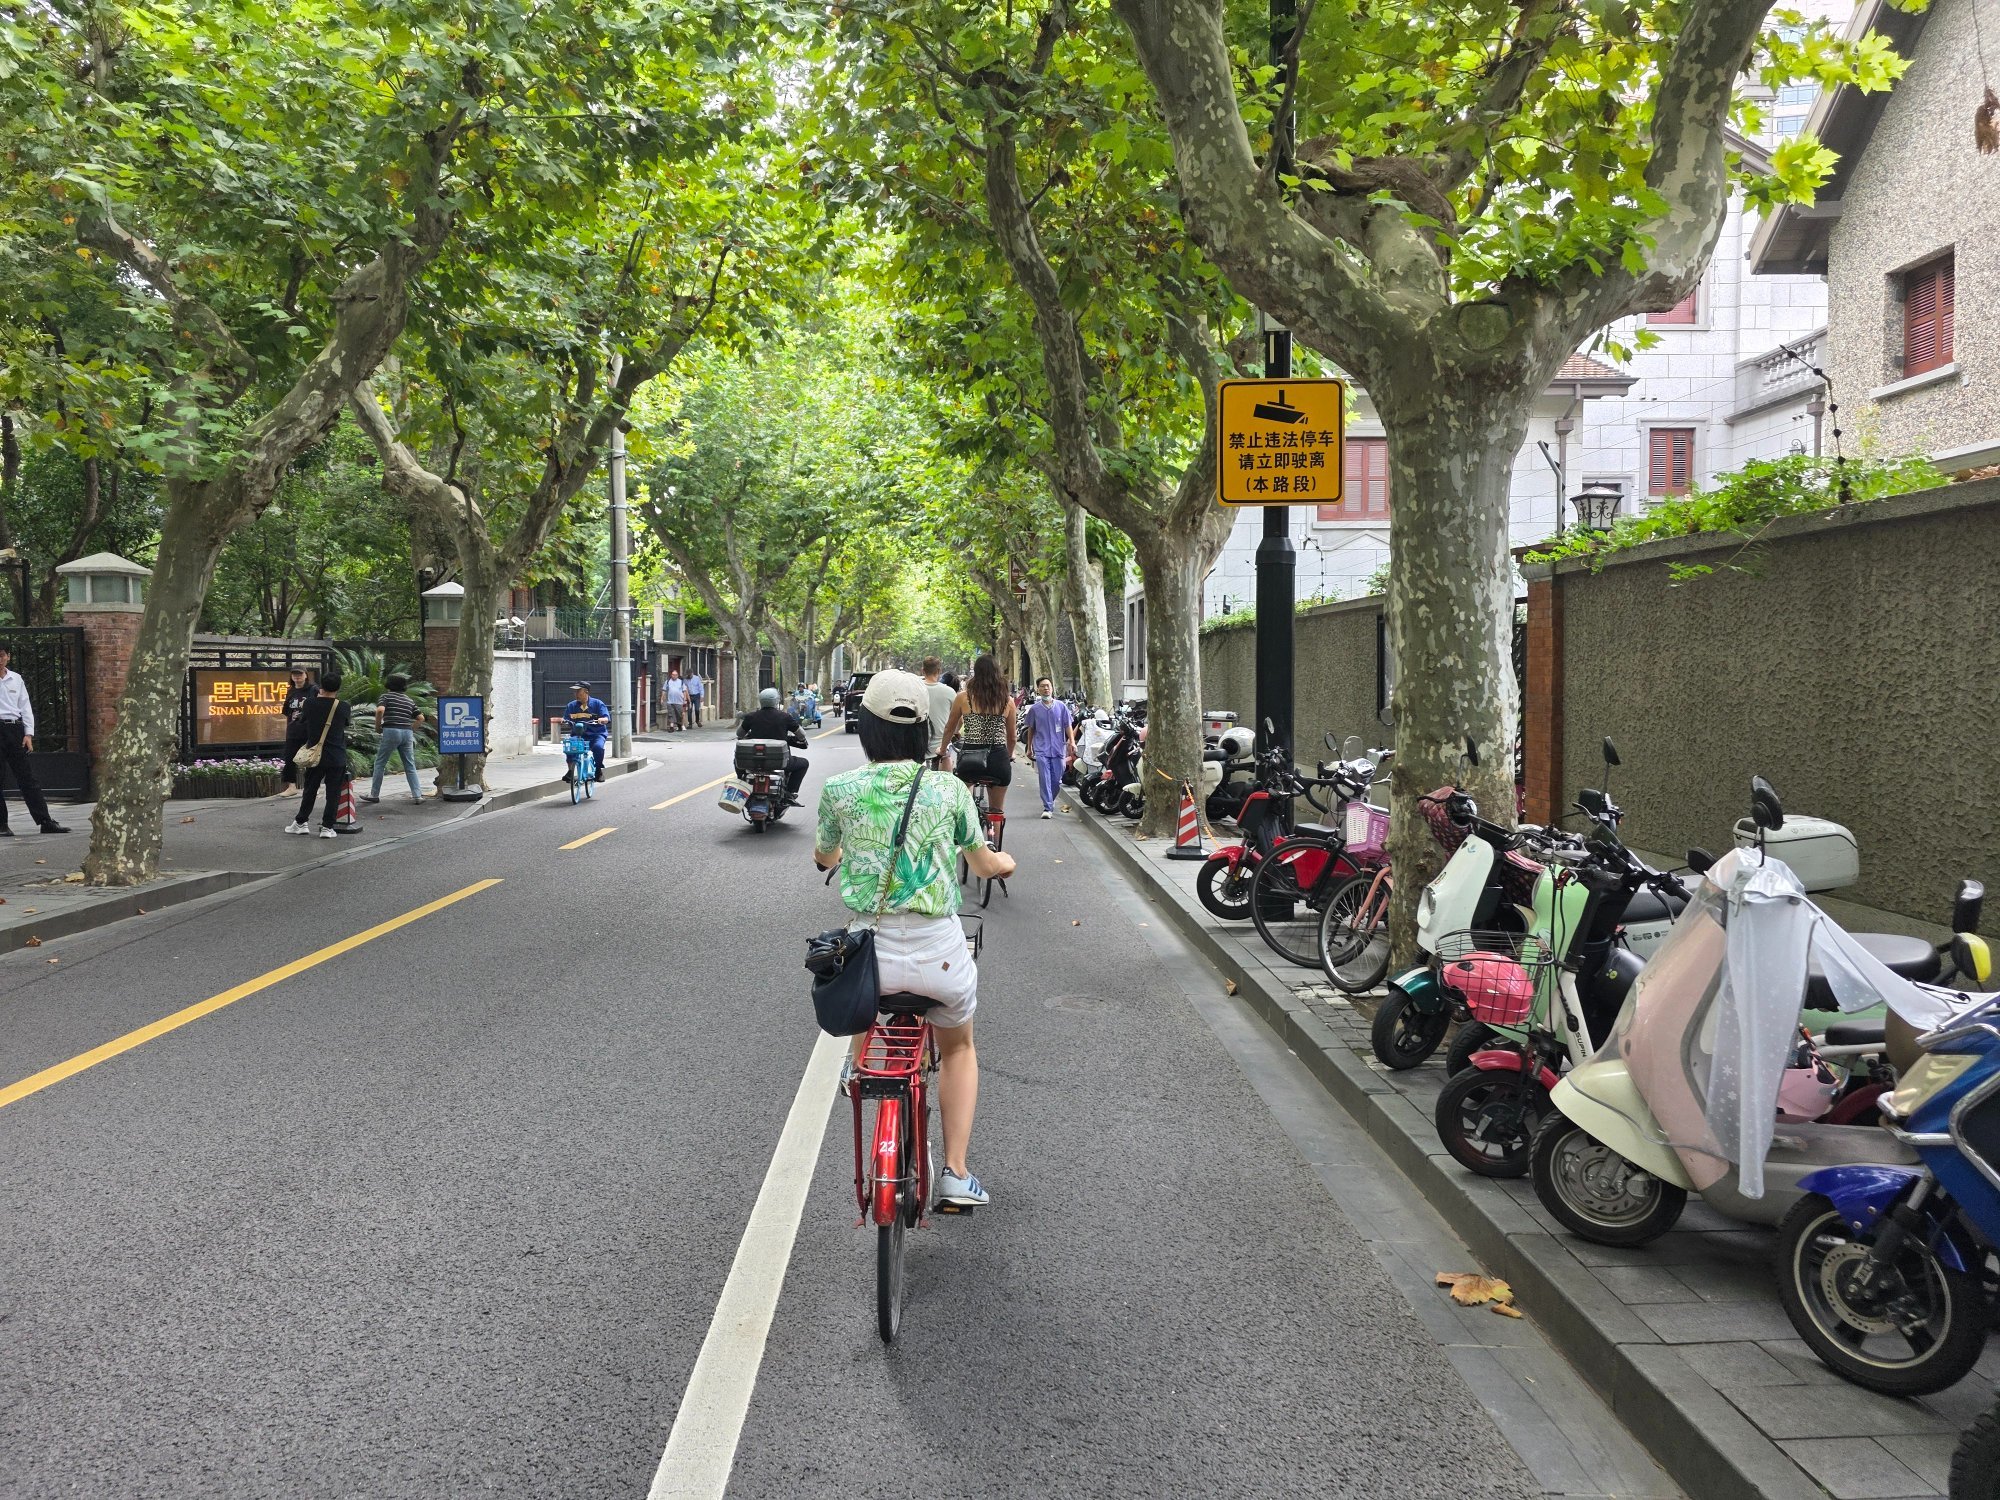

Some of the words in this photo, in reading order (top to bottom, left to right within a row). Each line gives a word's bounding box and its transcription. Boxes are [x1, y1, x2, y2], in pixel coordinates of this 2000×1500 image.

[1229, 430, 1334, 449] 禁止违法停车
[1239, 451, 1325, 470] 请立即驶离
[208, 705, 244, 715] SINAN
[246, 704, 283, 715] MANSI
[879, 1141, 896, 1153] 22
